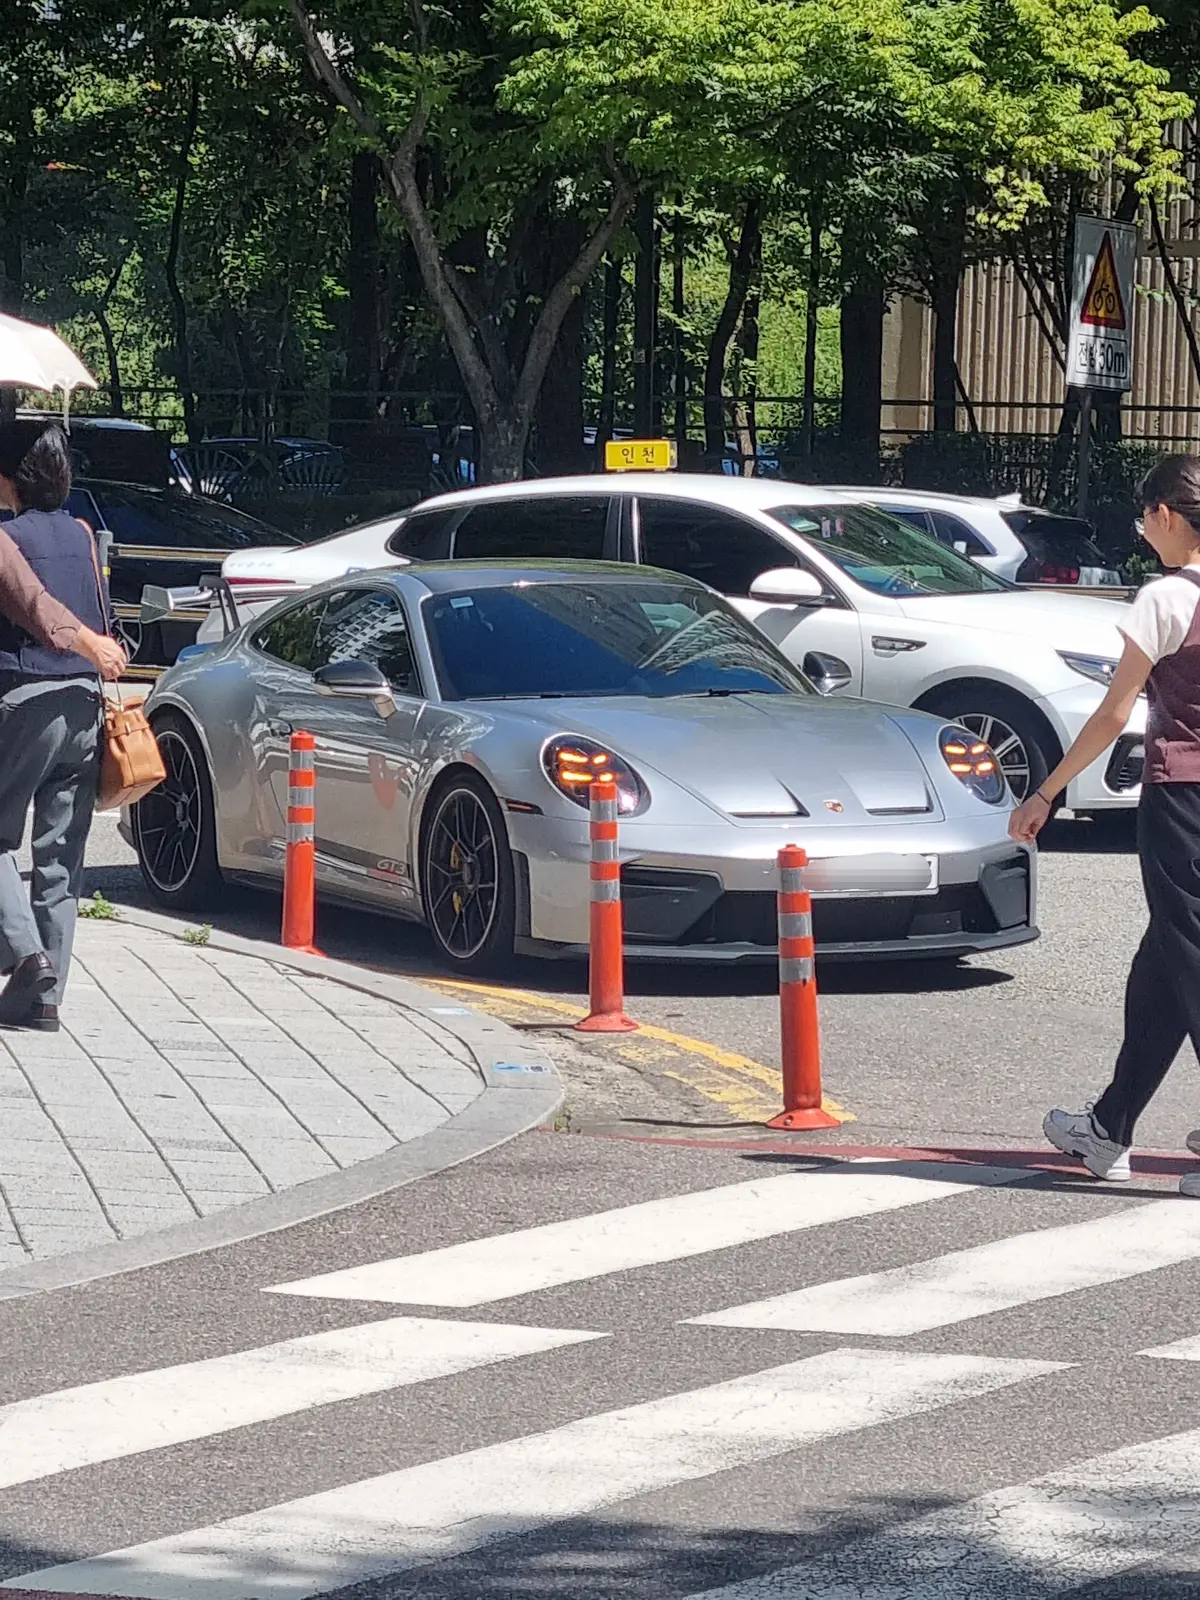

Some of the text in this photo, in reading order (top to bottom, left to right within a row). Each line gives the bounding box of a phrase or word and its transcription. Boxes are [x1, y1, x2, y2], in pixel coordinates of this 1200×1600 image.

[1099, 343, 1125, 373] 50m
[621, 446, 655, 464] 인천
[376, 859, 406, 875] GT3
